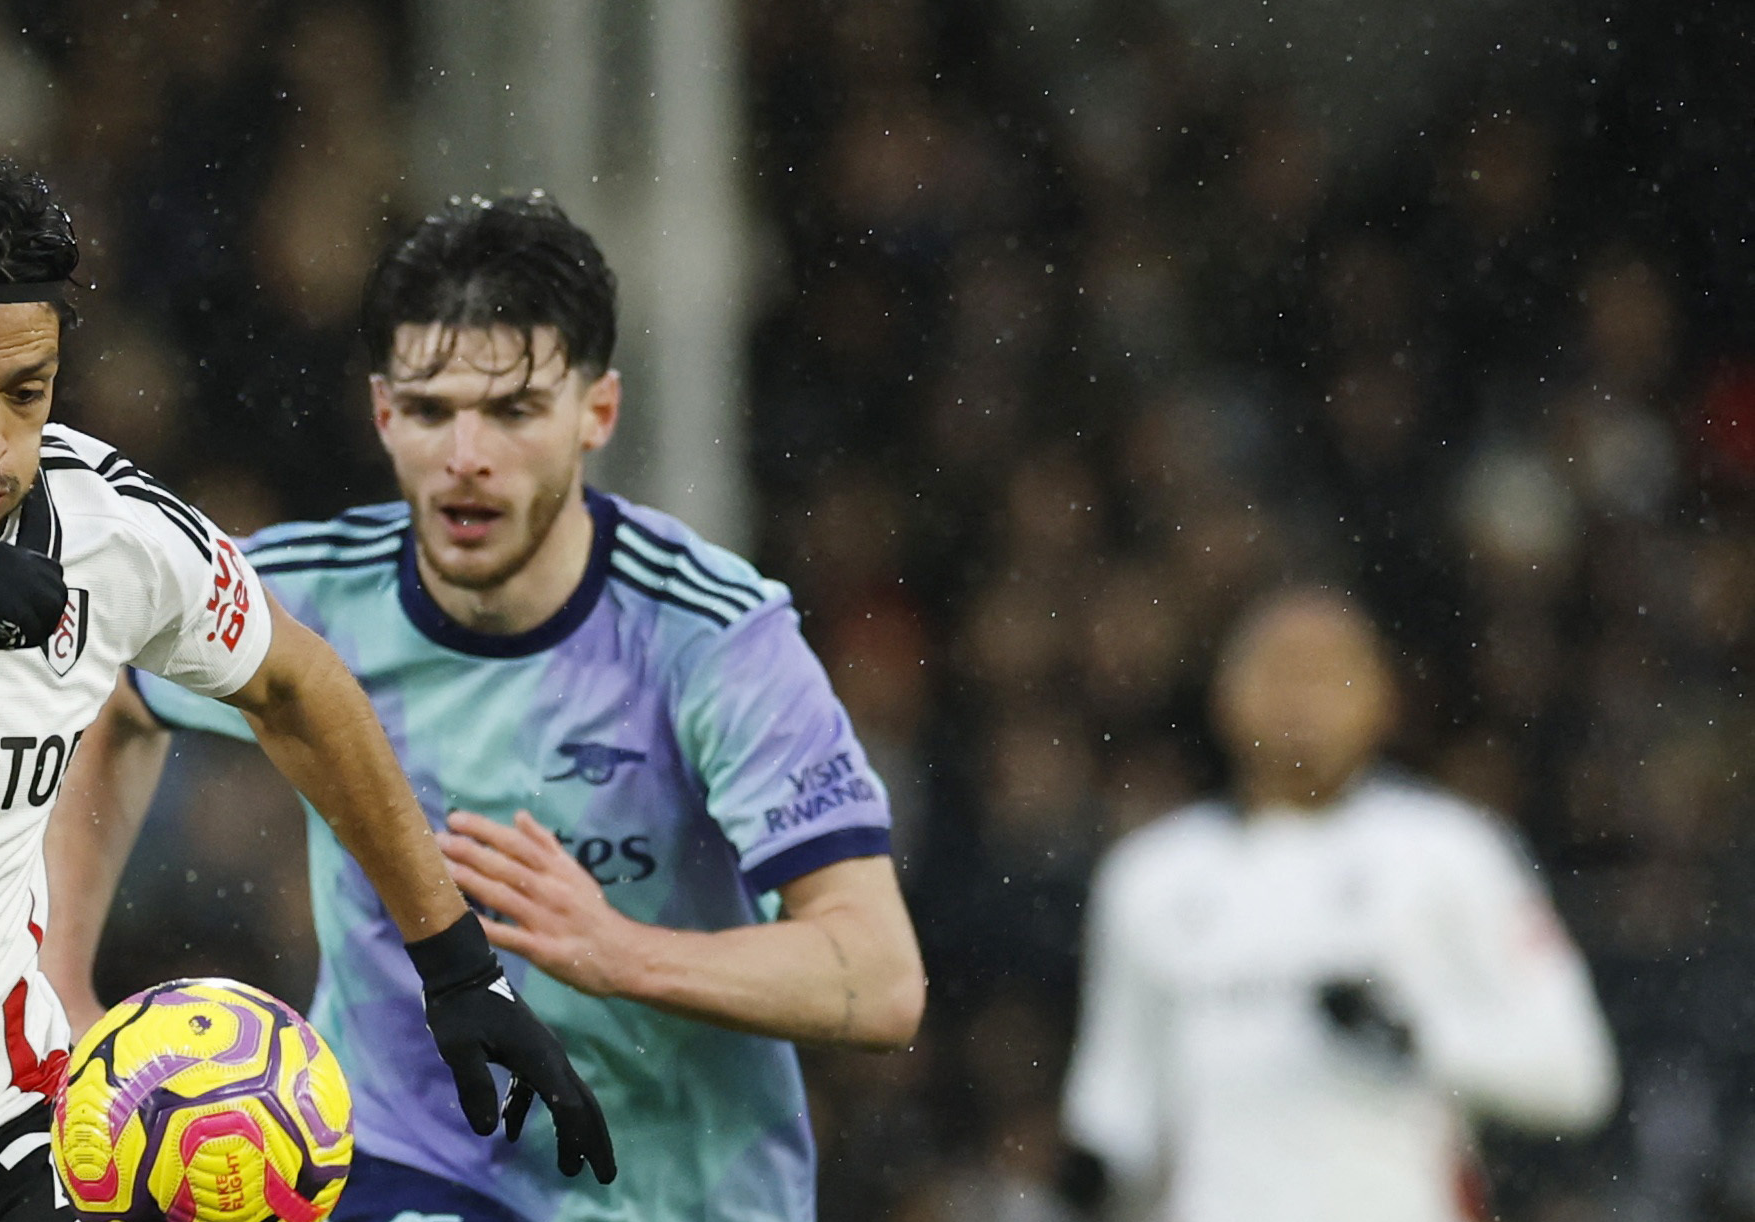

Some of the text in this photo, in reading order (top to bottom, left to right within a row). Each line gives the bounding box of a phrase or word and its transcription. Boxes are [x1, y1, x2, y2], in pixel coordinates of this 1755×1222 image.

[787, 752, 853, 794] VISIT
[216, 1174, 230, 1212] NIKE
[226, 1153, 245, 1212] FLIGHT
